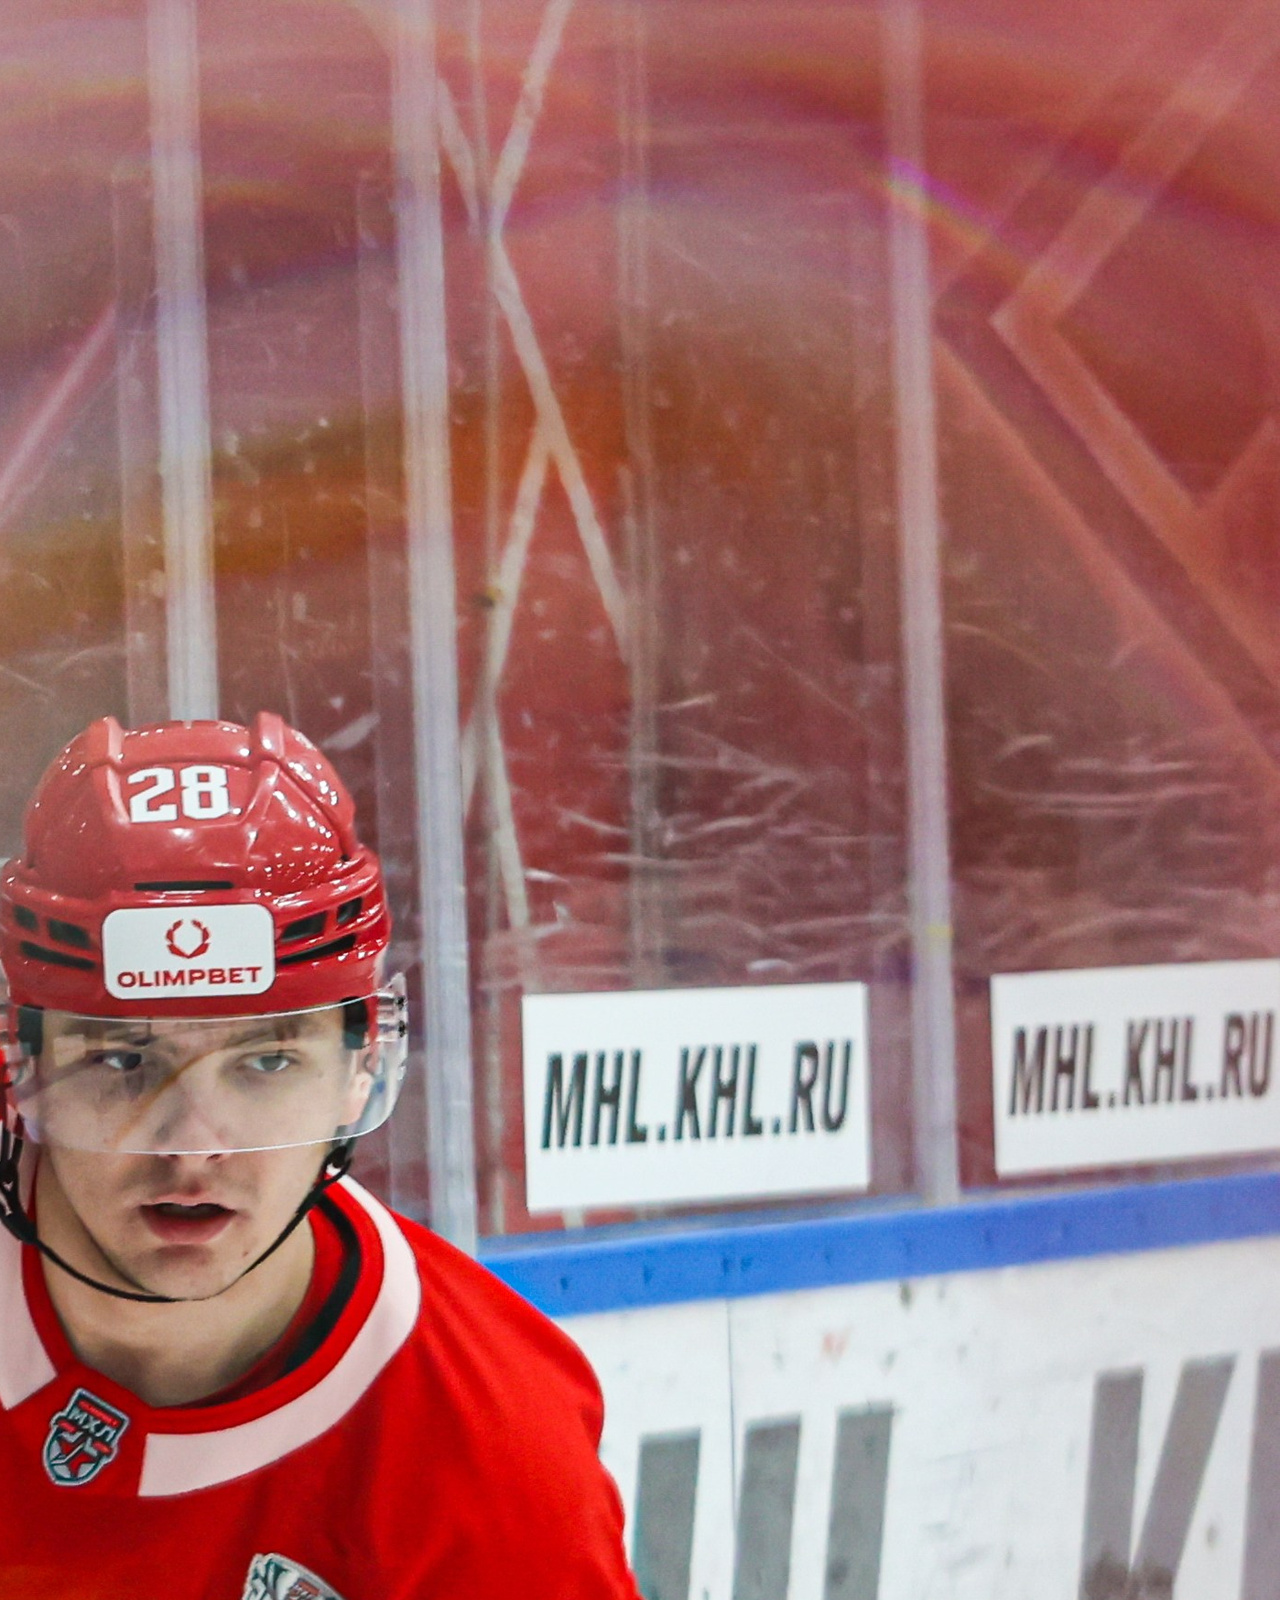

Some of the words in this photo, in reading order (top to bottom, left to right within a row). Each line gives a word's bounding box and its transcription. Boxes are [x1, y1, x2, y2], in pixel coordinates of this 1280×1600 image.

[126, 765, 231, 823] 28
[117, 966, 263, 988] OLIMPBET
[540, 1040, 853, 1150] MHL.KHL.RU
[1009, 1010, 1276, 1117] MHL.KHL.RU
